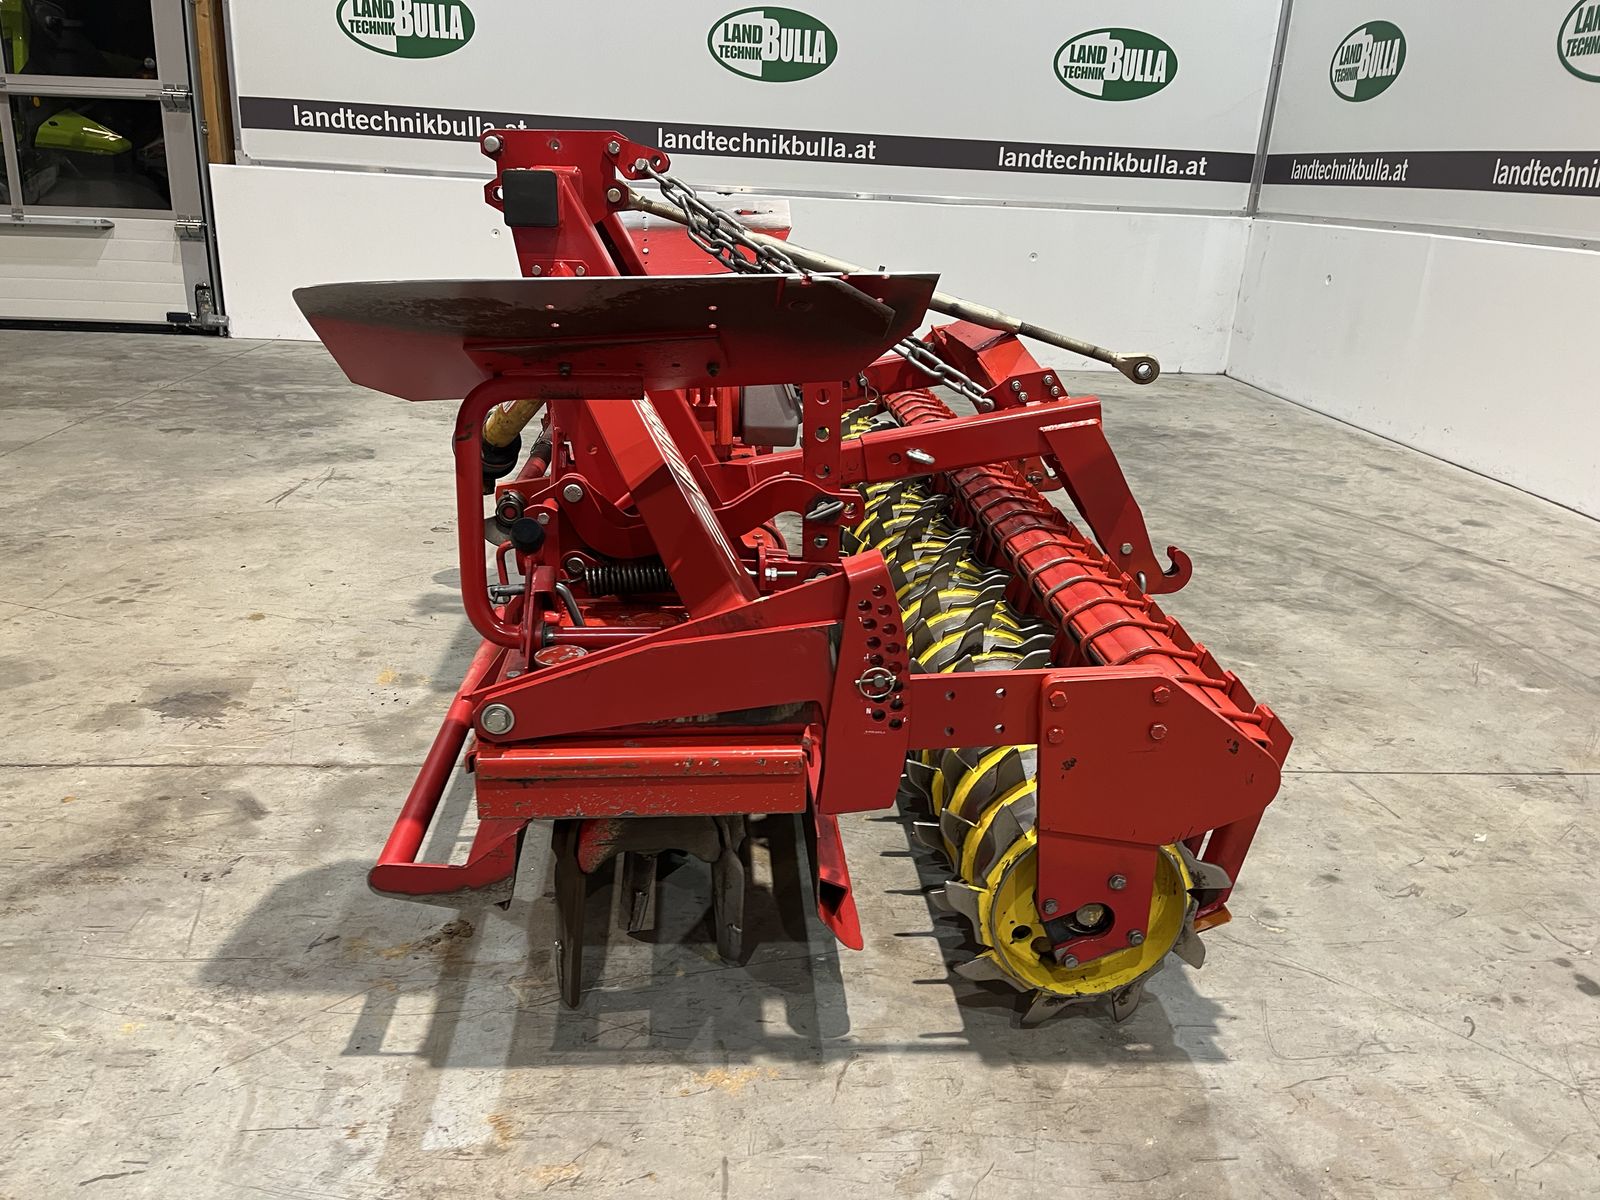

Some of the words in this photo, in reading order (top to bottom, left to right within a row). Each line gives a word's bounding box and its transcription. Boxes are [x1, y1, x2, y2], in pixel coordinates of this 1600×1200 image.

[351, 0, 395, 19] LAND
[395, 0, 465, 41] BULLA
[348, 19, 397, 36] TECHNIK
[723, 23, 763, 45] LAND
[718, 44, 763, 61] TECHNIK
[761, 18, 827, 64] BULLA
[1069, 44, 1108, 65] LAND
[1104, 39, 1168, 83] BULLA
[1339, 43, 1363, 66] LAND
[1357, 33, 1401, 80] BULLA
[1063, 65, 1106, 80] TECHNIK
[1334, 66, 1360, 83] TECHNIK
[657, 127, 877, 160] landtechnikbulla.at
[998, 146, 1208, 176] landtechnikbulla.at
[1290, 158, 1409, 182] landtechnikbulla.at
